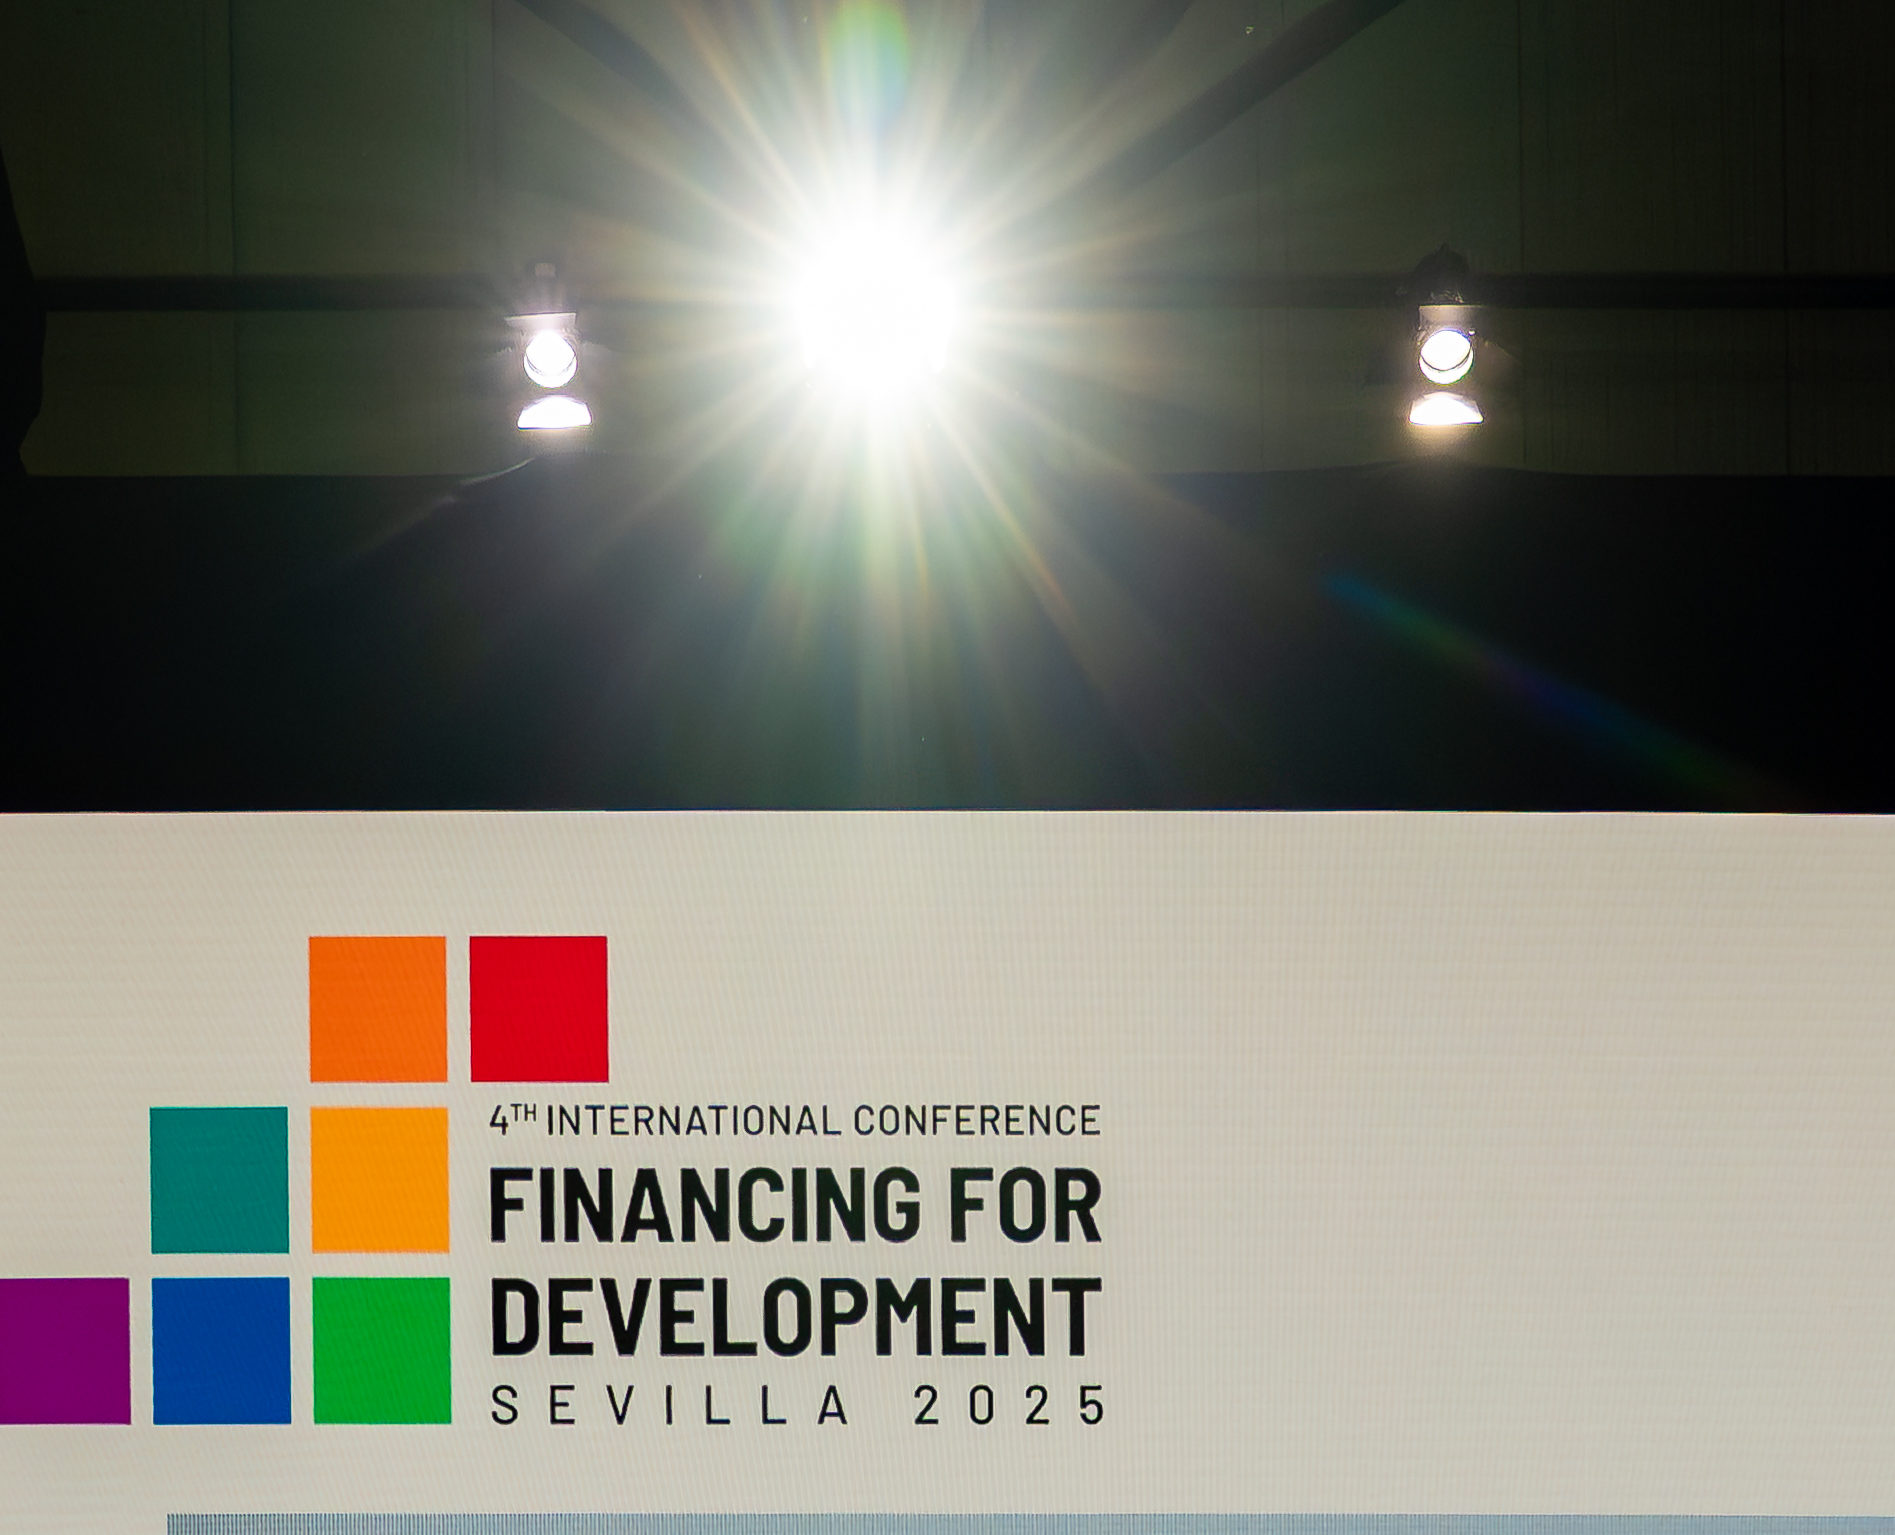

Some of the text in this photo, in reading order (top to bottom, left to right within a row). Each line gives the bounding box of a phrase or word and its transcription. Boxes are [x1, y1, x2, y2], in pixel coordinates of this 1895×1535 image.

[489, 1103, 1102, 1136] 4TH INTERNATIONAL CONFERENCE
[489, 1166, 1103, 1244] FINANCING FOR
[491, 1277, 1104, 1357] DEVELOPMENT
[491, 1384, 1105, 1426] SEVILLA 2025
